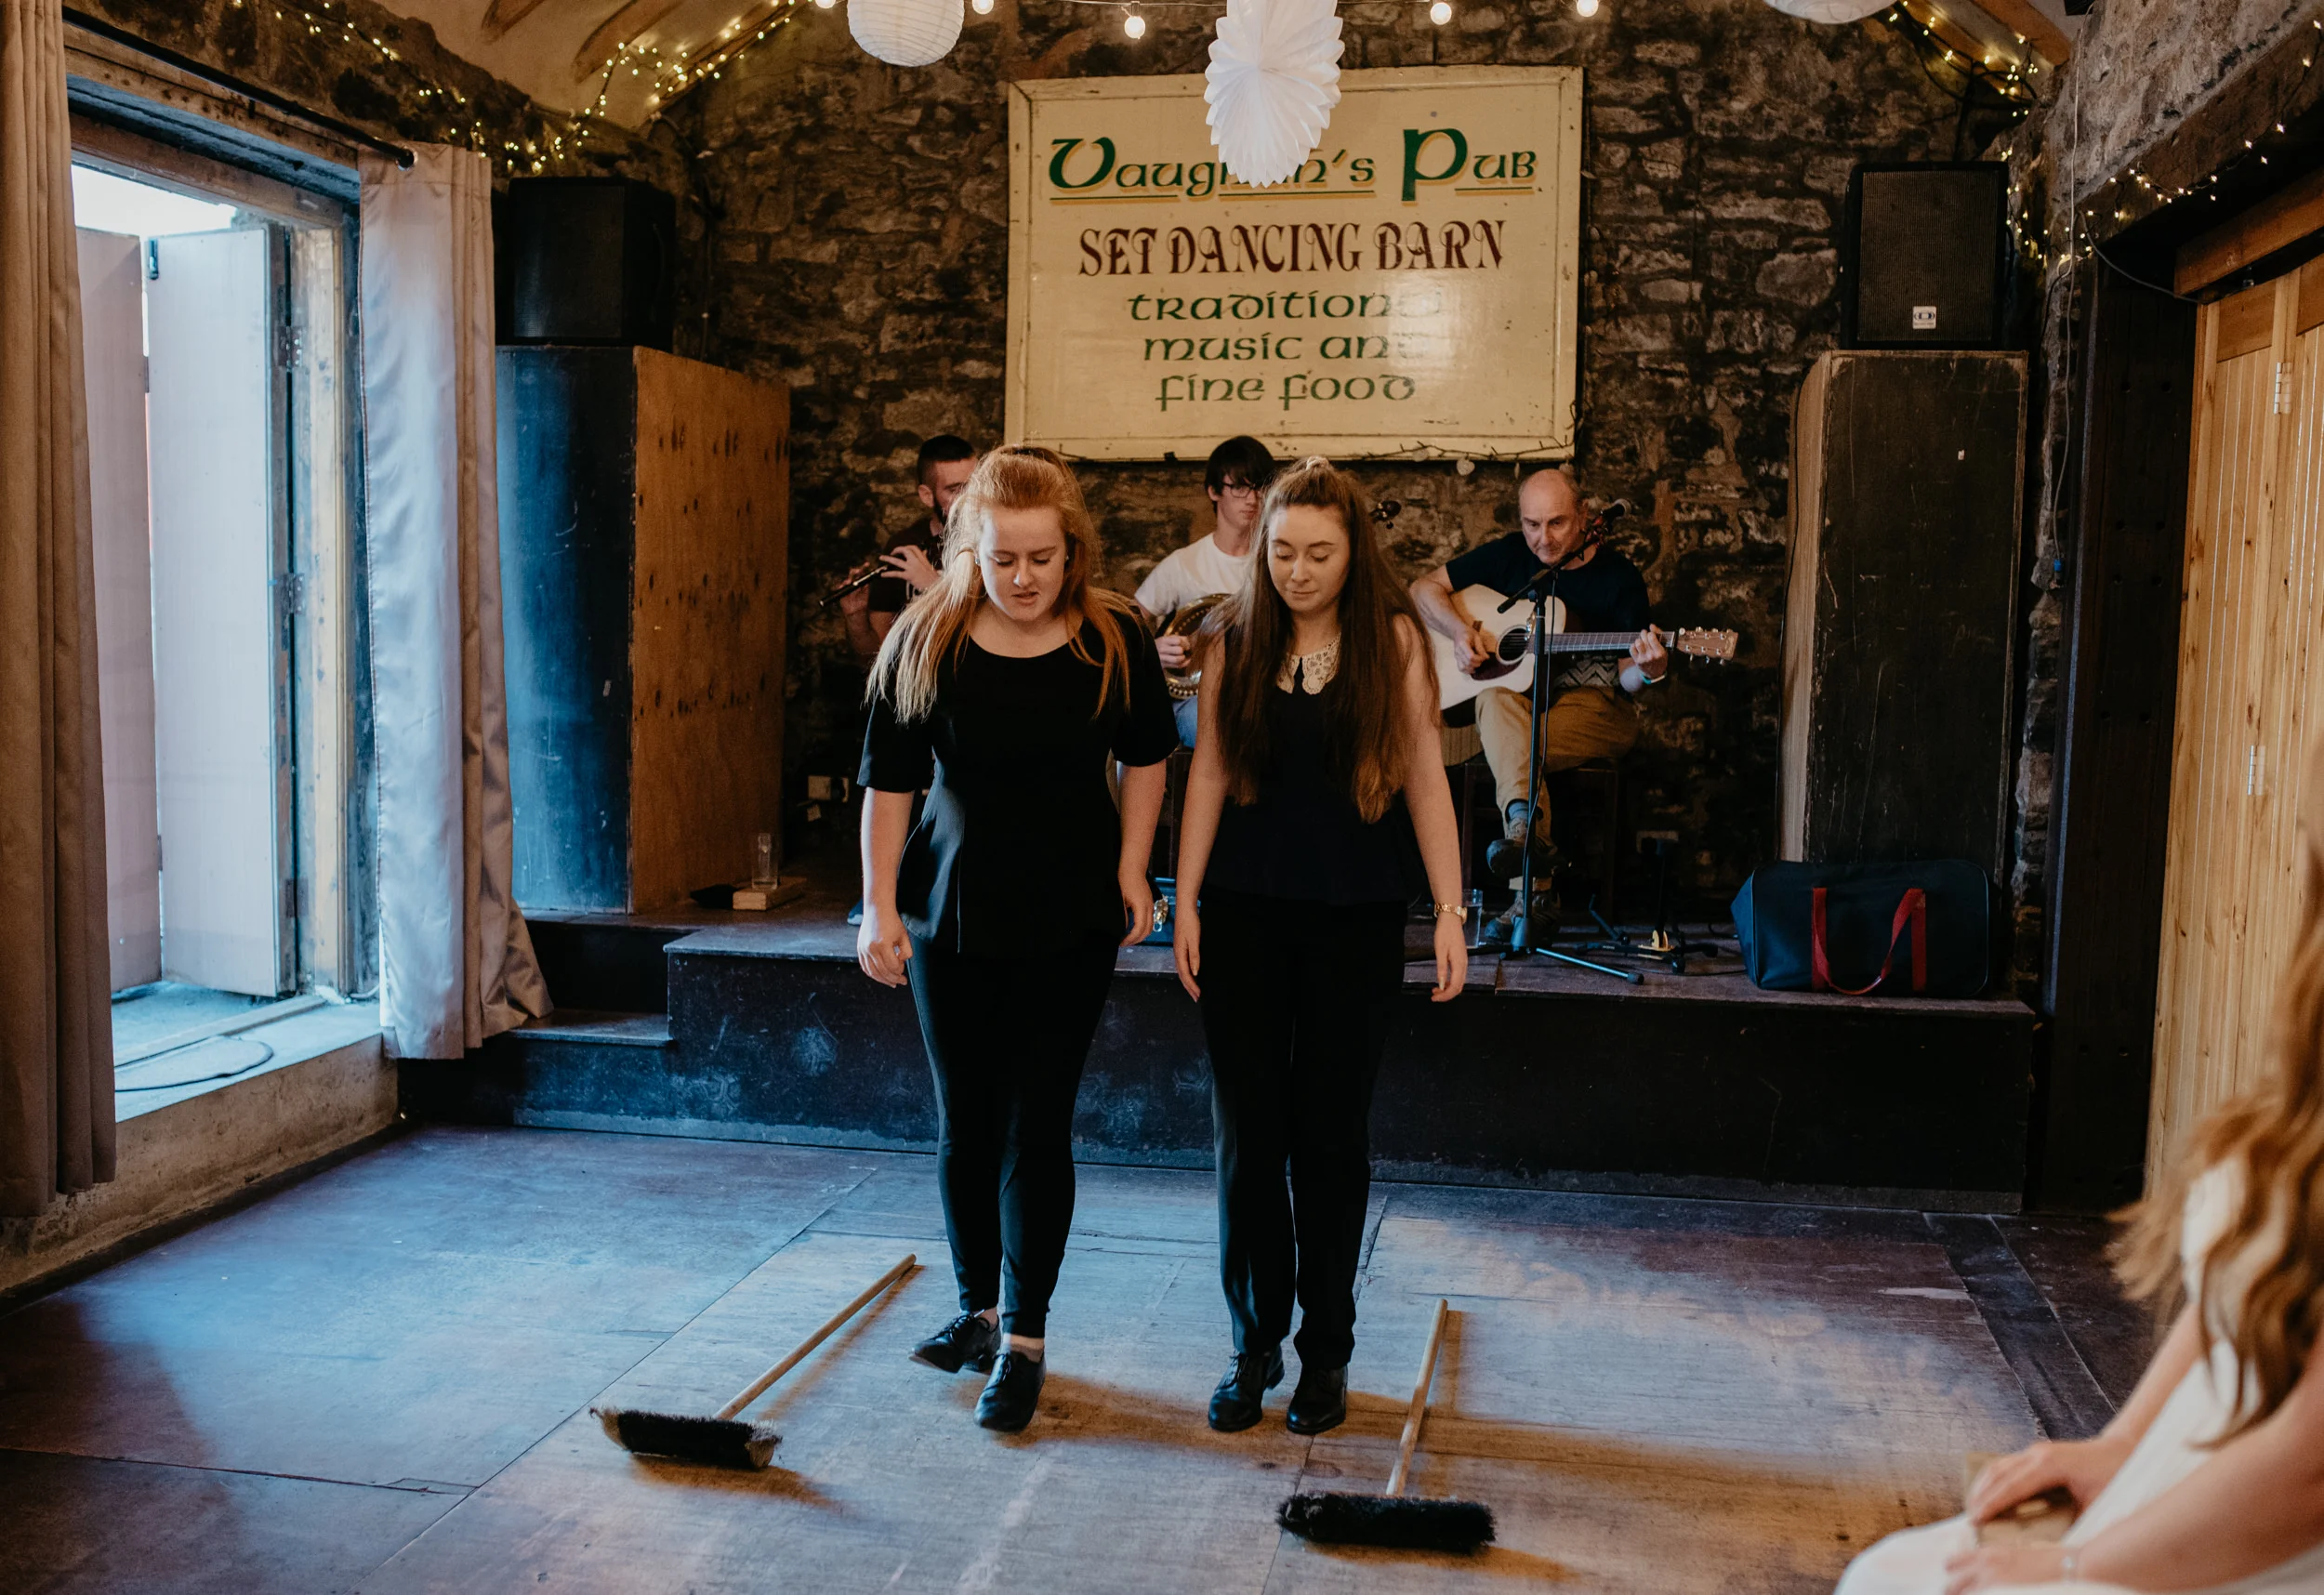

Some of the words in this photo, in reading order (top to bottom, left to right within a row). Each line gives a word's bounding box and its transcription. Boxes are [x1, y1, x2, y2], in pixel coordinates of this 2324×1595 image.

[1049, 137, 1376, 197] Vaugn's
[1078, 227, 1158, 277] SET
[1166, 222, 1364, 274] DANCING
[1372, 219, 1508, 270] BARN
[1128, 290, 1441, 321] tradition
[1144, 332, 1303, 361] music
[1320, 336, 1423, 360] an
[1155, 374, 1265, 412] fine
[1278, 374, 1416, 411] food
